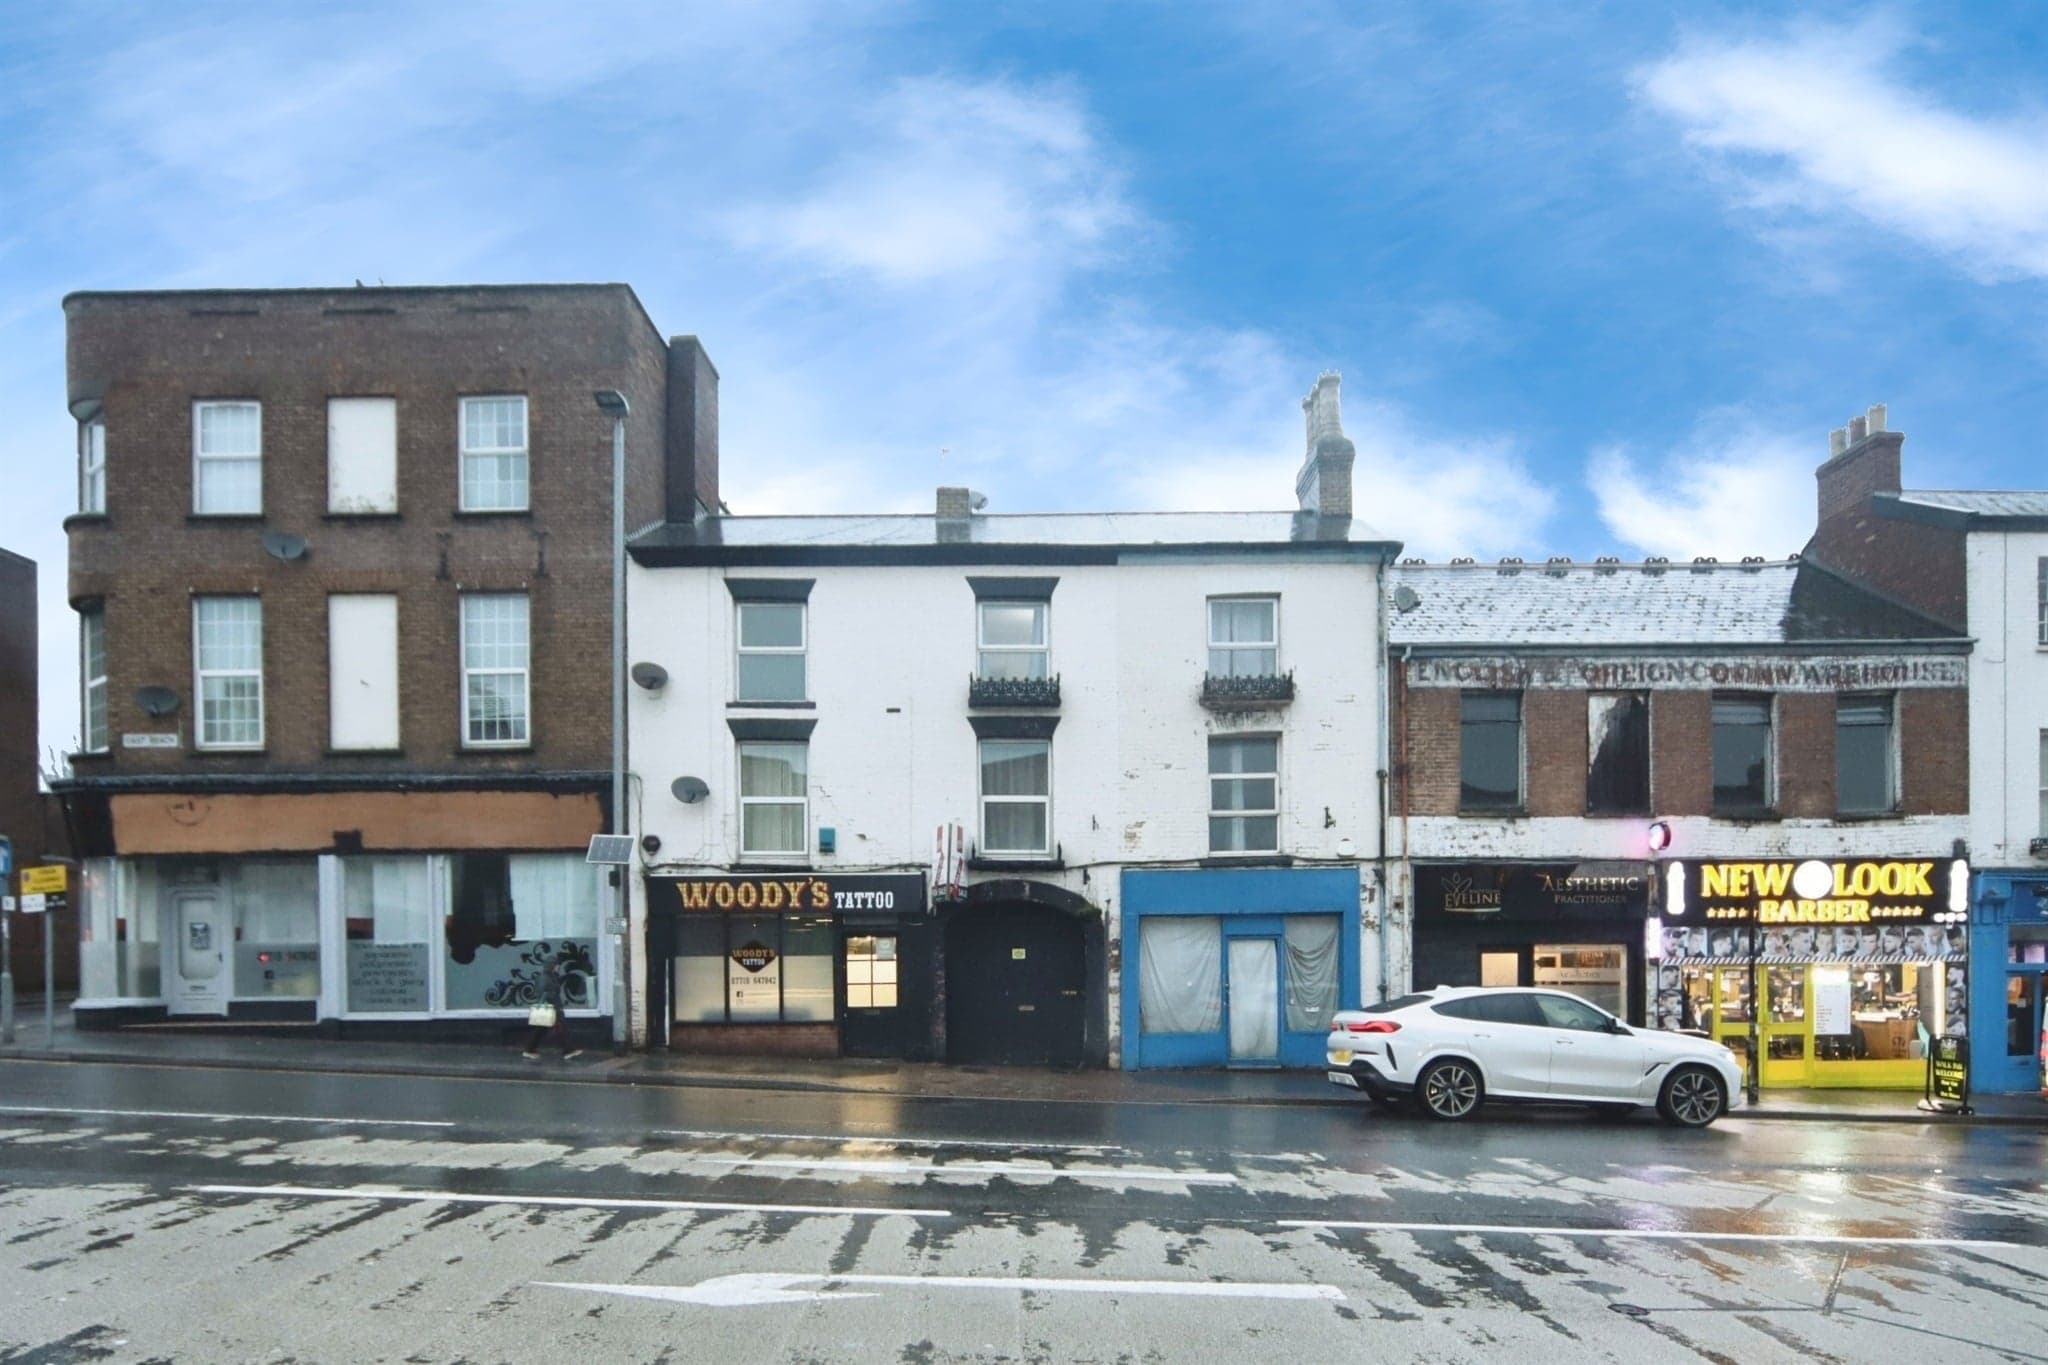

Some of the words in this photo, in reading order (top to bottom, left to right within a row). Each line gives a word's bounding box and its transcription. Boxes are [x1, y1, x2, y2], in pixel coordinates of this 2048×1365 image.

[1542, 876, 1639, 892] AESTHETIC
[1700, 863, 1795, 897] NEW
[1831, 862, 1935, 896] LOOK
[675, 877, 831, 909] WOODY'S
[834, 891, 894, 909] TATTOO
[1445, 892, 1502, 906] EVELINE
[1554, 894, 1629, 905] PRACTITIONER
[1759, 900, 1870, 922] BARBER
[742, 958, 766, 966] TATTOO
